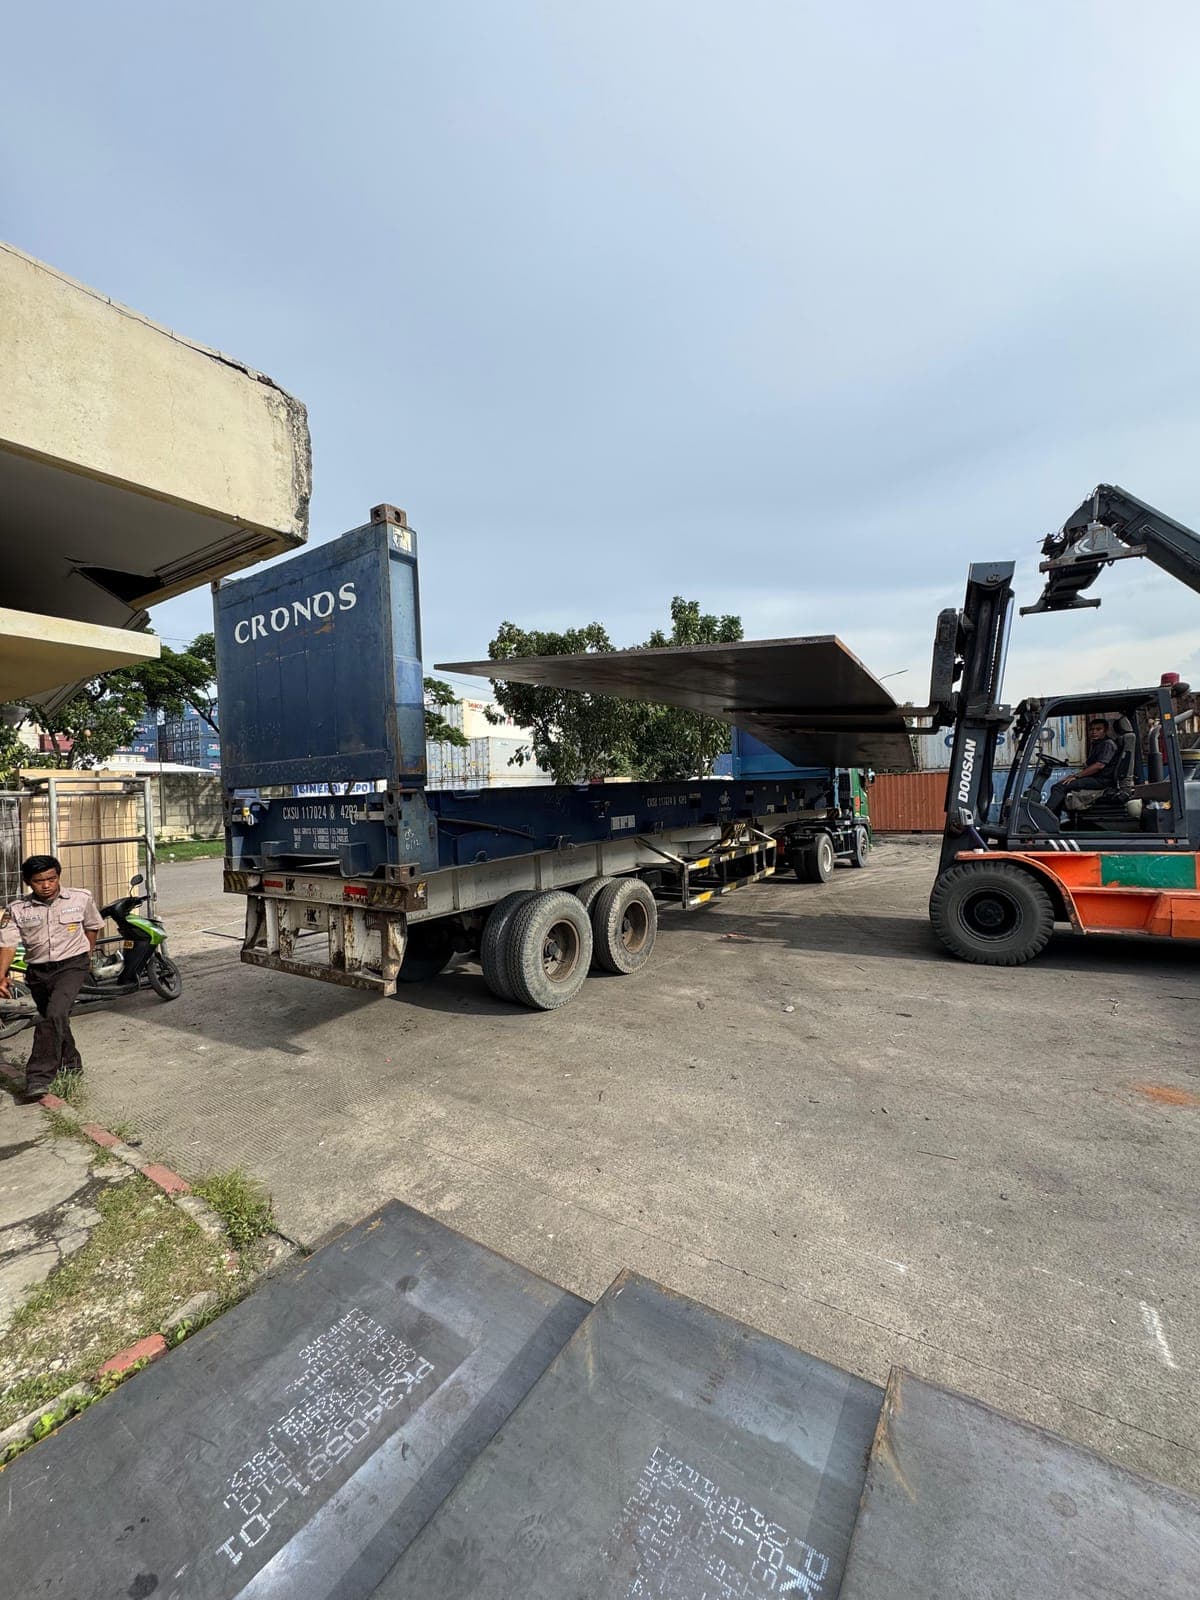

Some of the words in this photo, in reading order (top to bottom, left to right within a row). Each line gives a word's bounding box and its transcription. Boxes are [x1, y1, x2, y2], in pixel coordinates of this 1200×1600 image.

[234, 581, 357, 644] CRONOS
[957, 738, 977, 803] DOOSAN
[282, 806, 300, 820] CXSU
[302, 805, 327, 820] 117024
[329, 804, 336, 820] 8
